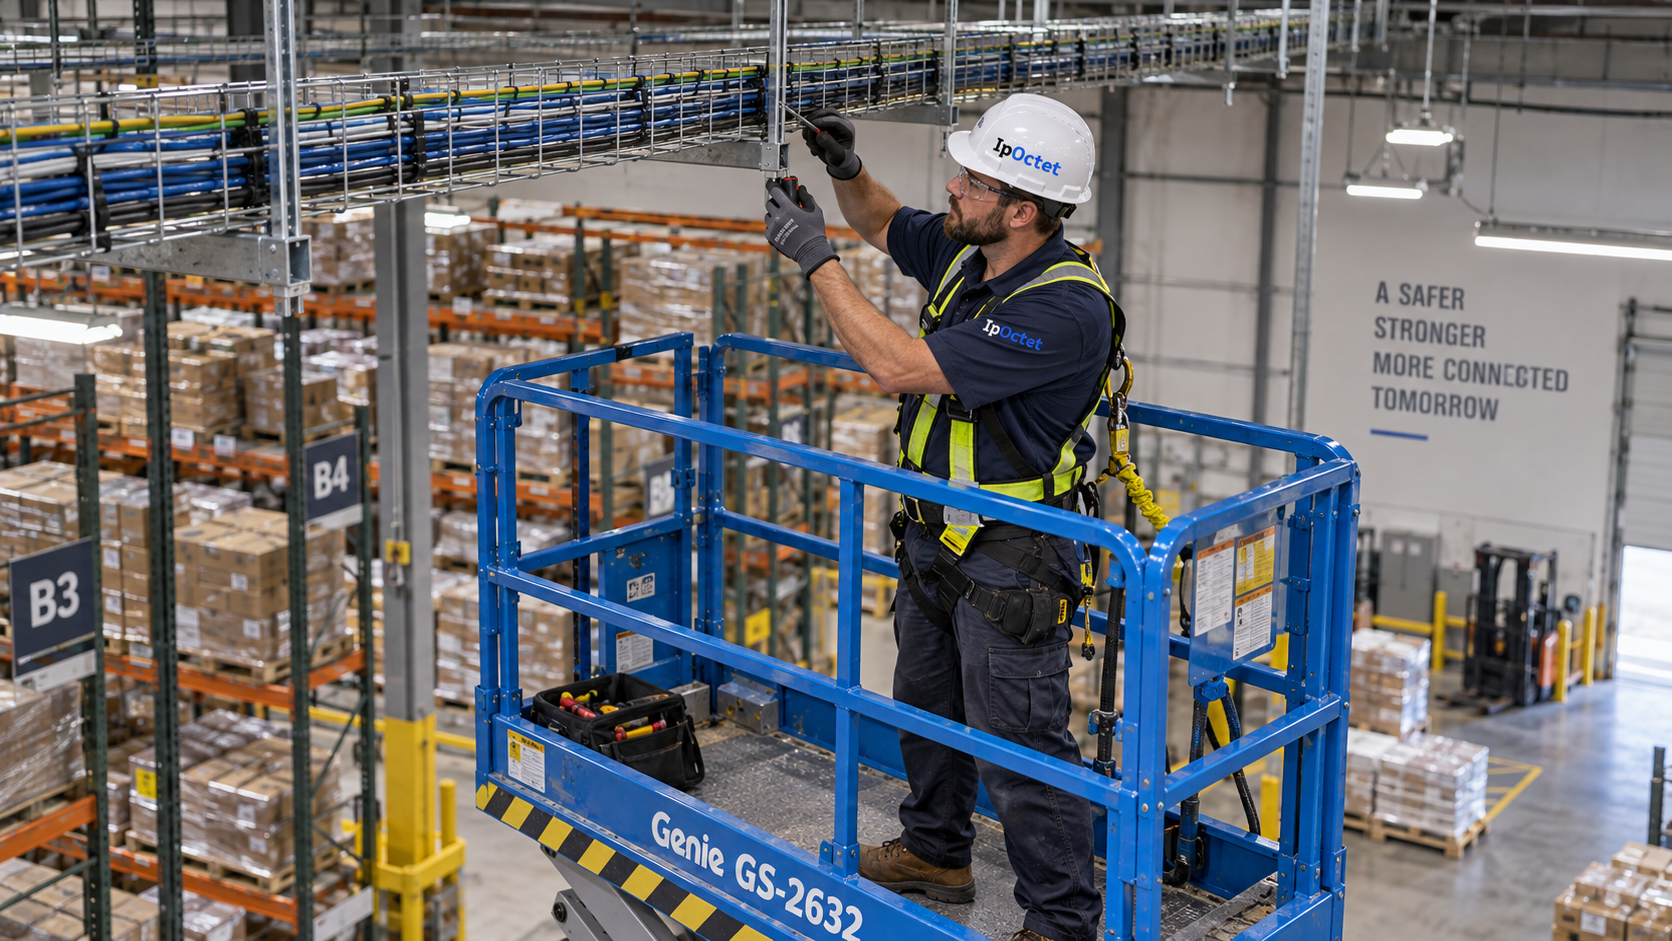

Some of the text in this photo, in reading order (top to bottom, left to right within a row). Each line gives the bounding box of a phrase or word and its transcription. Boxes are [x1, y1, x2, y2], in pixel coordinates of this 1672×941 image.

[993, 137, 1061, 176] IpOctet
[1375, 281, 1465, 311] A SAFER
[982, 318, 1043, 351] IpOctet
[1374, 316, 1486, 348] STRONGER
[1373, 351, 1569, 393] MORE CONNECTED
[1371, 386, 1499, 421] TOMORROW
[314, 455, 350, 500] B4
[30, 571, 80, 629] B3
[651, 811, 863, 941] Genie GS-2632
